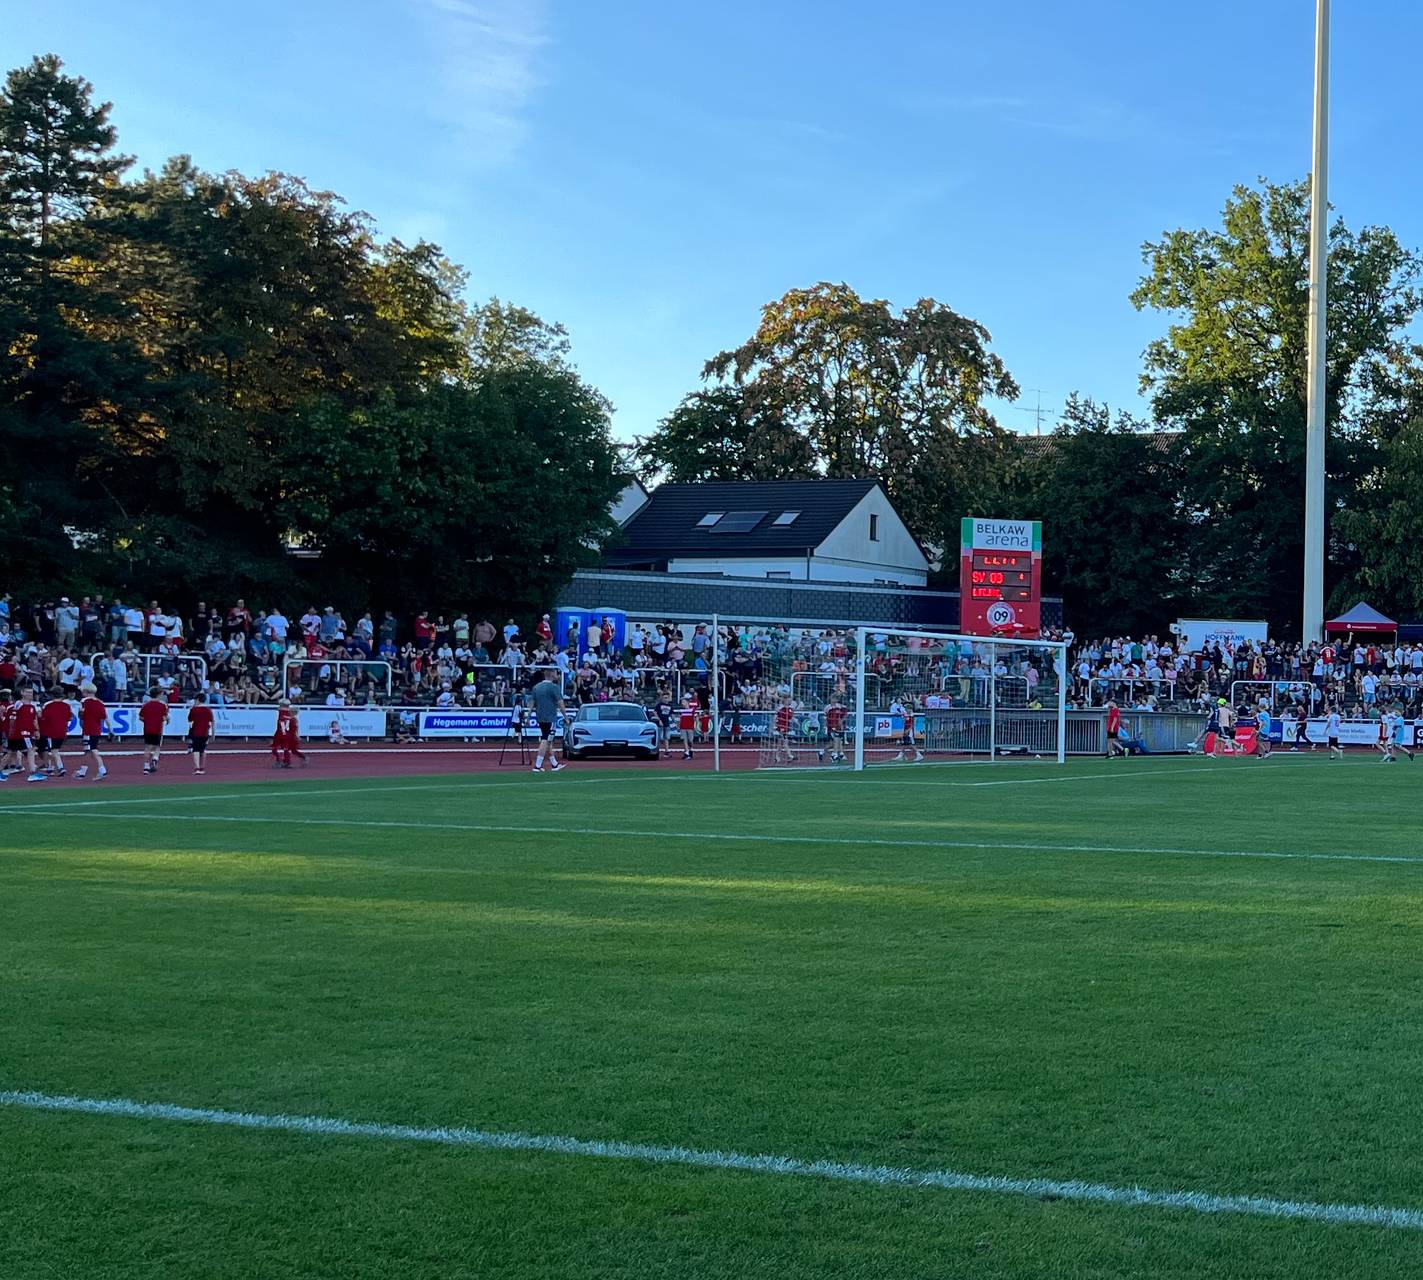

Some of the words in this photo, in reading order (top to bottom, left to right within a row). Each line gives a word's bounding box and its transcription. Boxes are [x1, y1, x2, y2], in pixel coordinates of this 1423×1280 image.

[977, 524, 1025, 535] BELKAW
[986, 535, 1029, 547] arena
[994, 611, 1008, 622] 09
[433, 718, 478, 728] Hegemann
[481, 718, 507, 727] GmbH
[878, 720, 890, 731] pb
